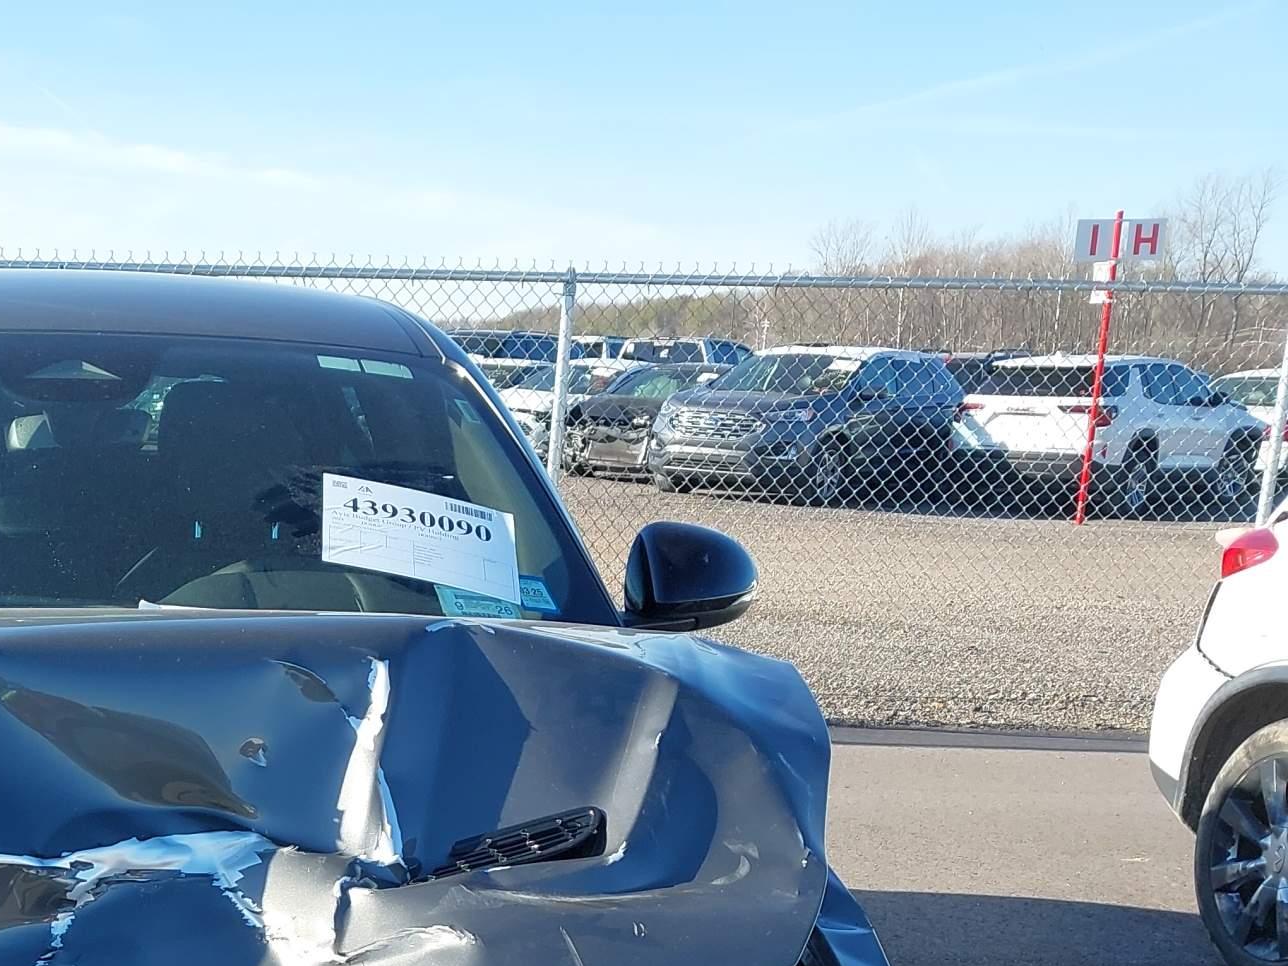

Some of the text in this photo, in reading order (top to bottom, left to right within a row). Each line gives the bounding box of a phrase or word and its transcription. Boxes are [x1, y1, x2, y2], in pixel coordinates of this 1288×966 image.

[1132, 223, 1160, 255] H
[343, 497, 492, 542] 43930090
[454, 601, 464, 611] 9
[495, 605, 513, 616] 26
